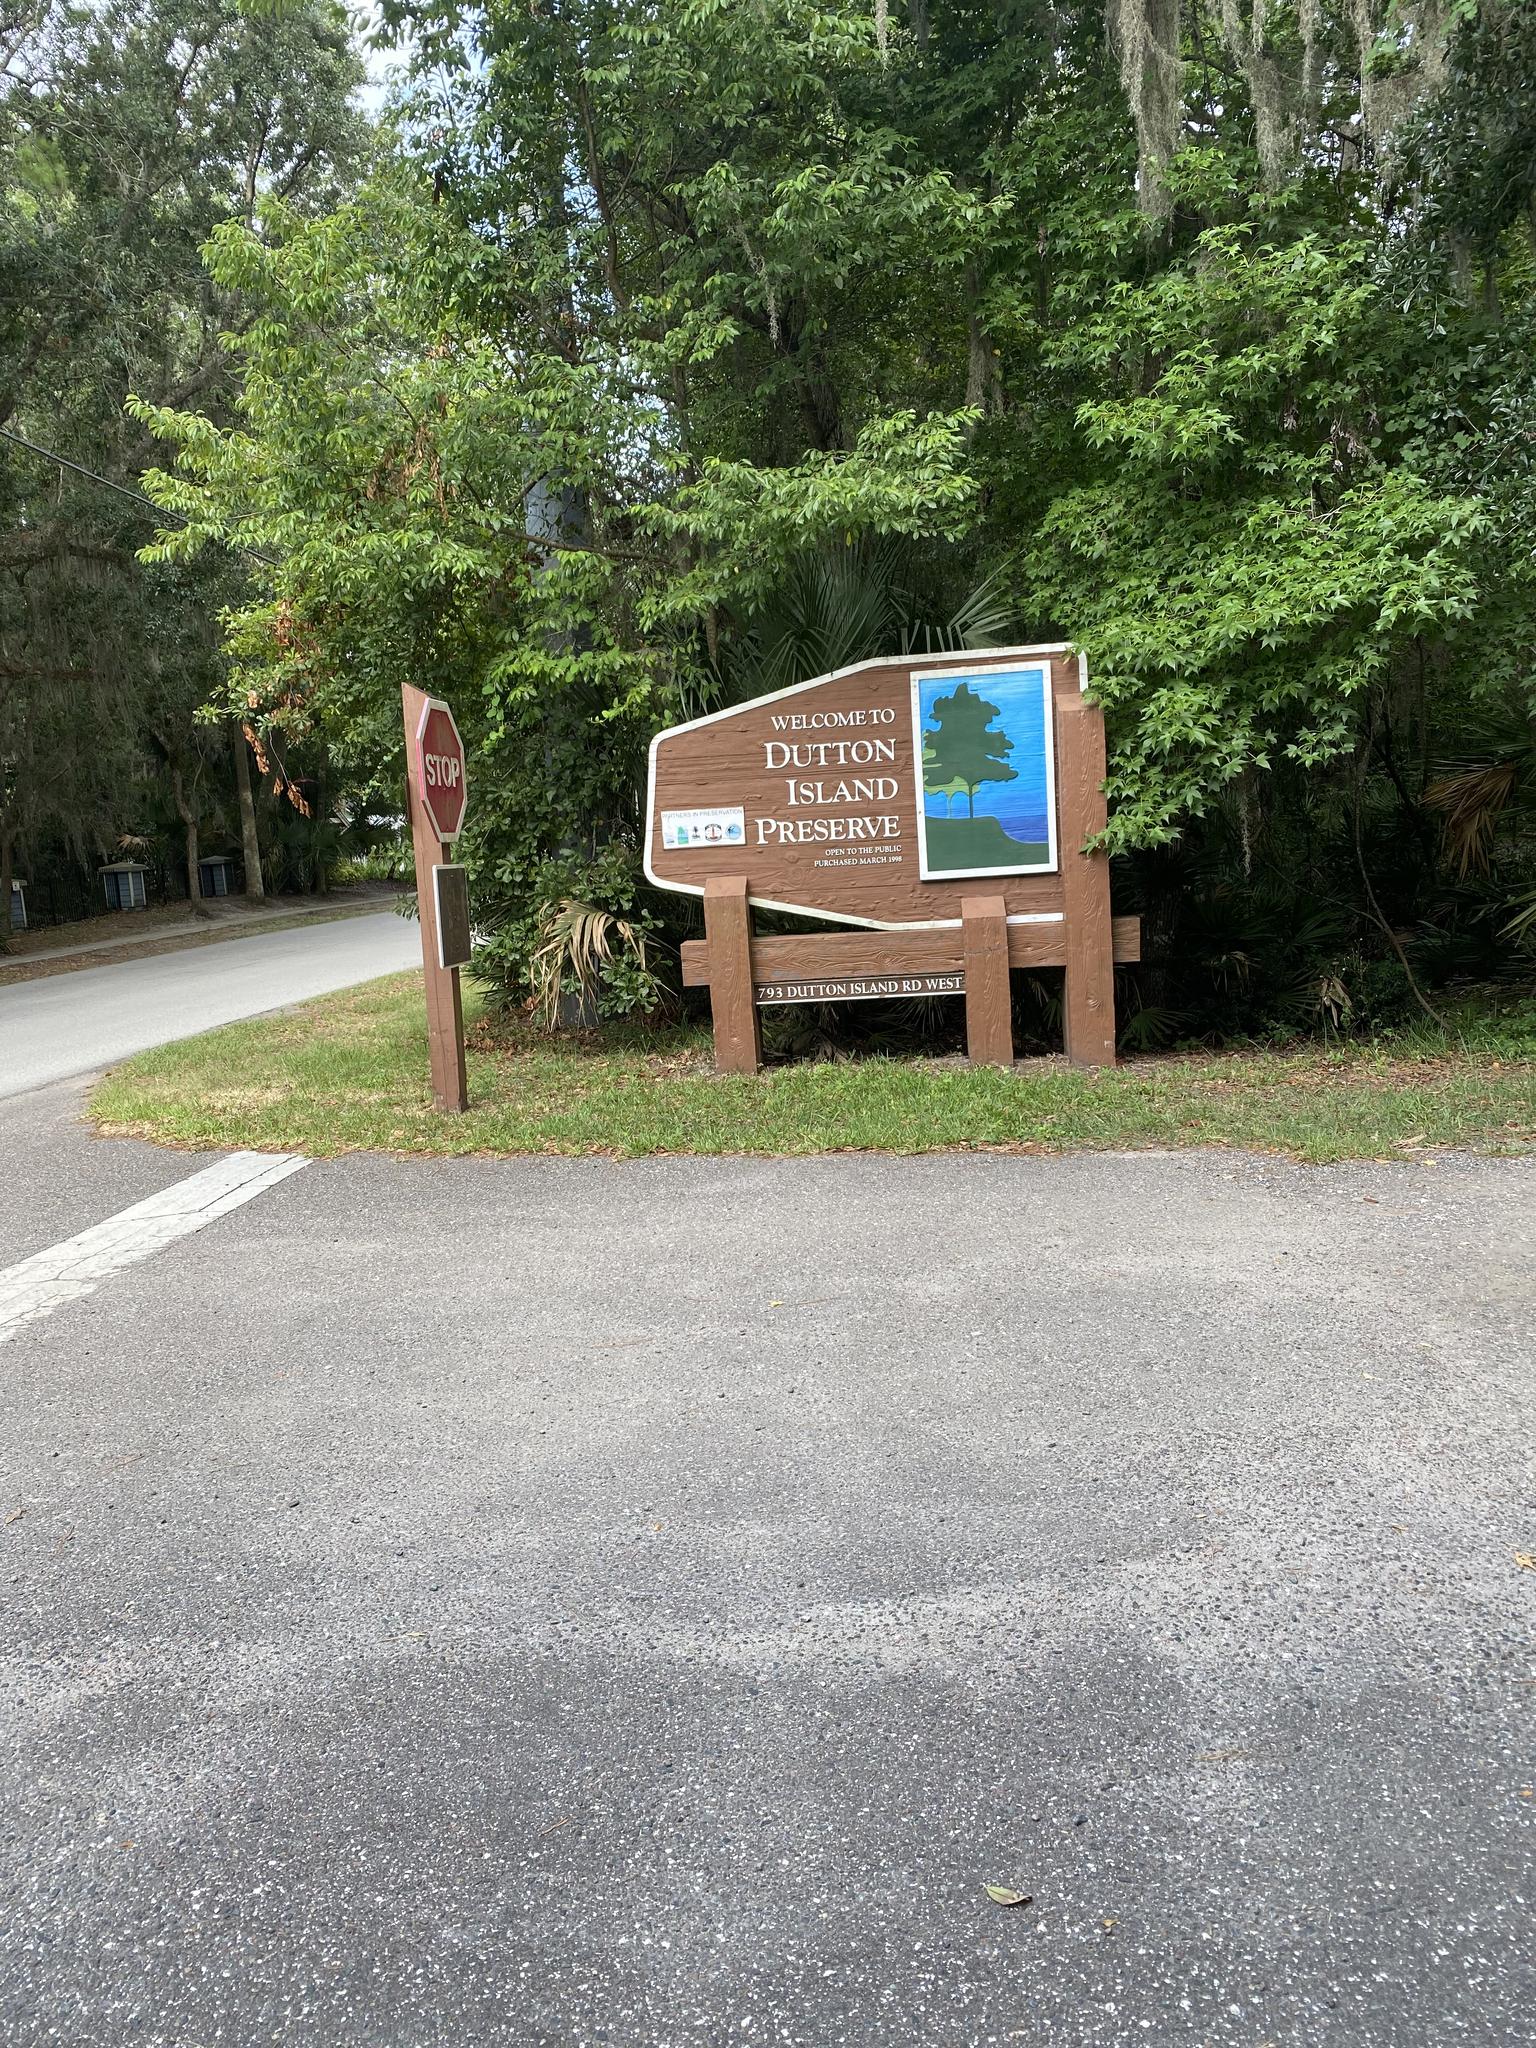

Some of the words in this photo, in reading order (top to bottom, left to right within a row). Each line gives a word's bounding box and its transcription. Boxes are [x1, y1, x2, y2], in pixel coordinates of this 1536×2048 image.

[771, 710, 866, 731] WELCOME
[869, 708, 895, 724] TO
[763, 738, 897, 769] DUTTON
[425, 753, 460, 788] STOP
[785, 777, 899, 806] ISLAND
[700, 809, 743, 817] PRESERVATION
[754, 815, 901, 845] PRESERVE
[814, 858, 858, 867] PURCHASED
[859, 856, 887, 865] MARCH
[888, 855, 903, 863] 1998
[825, 848, 845, 856] OPEN
[846, 847, 857, 855] TO
[858, 846, 874, 854] THE
[874, 845, 902, 853] PUBLIC
[758, 986, 783, 999] 793
[787, 983, 847, 998] DUTTON
[850, 980, 899, 994] ISLAND
[902, 979, 922, 992] RD
[926, 976, 963, 990] WEST
